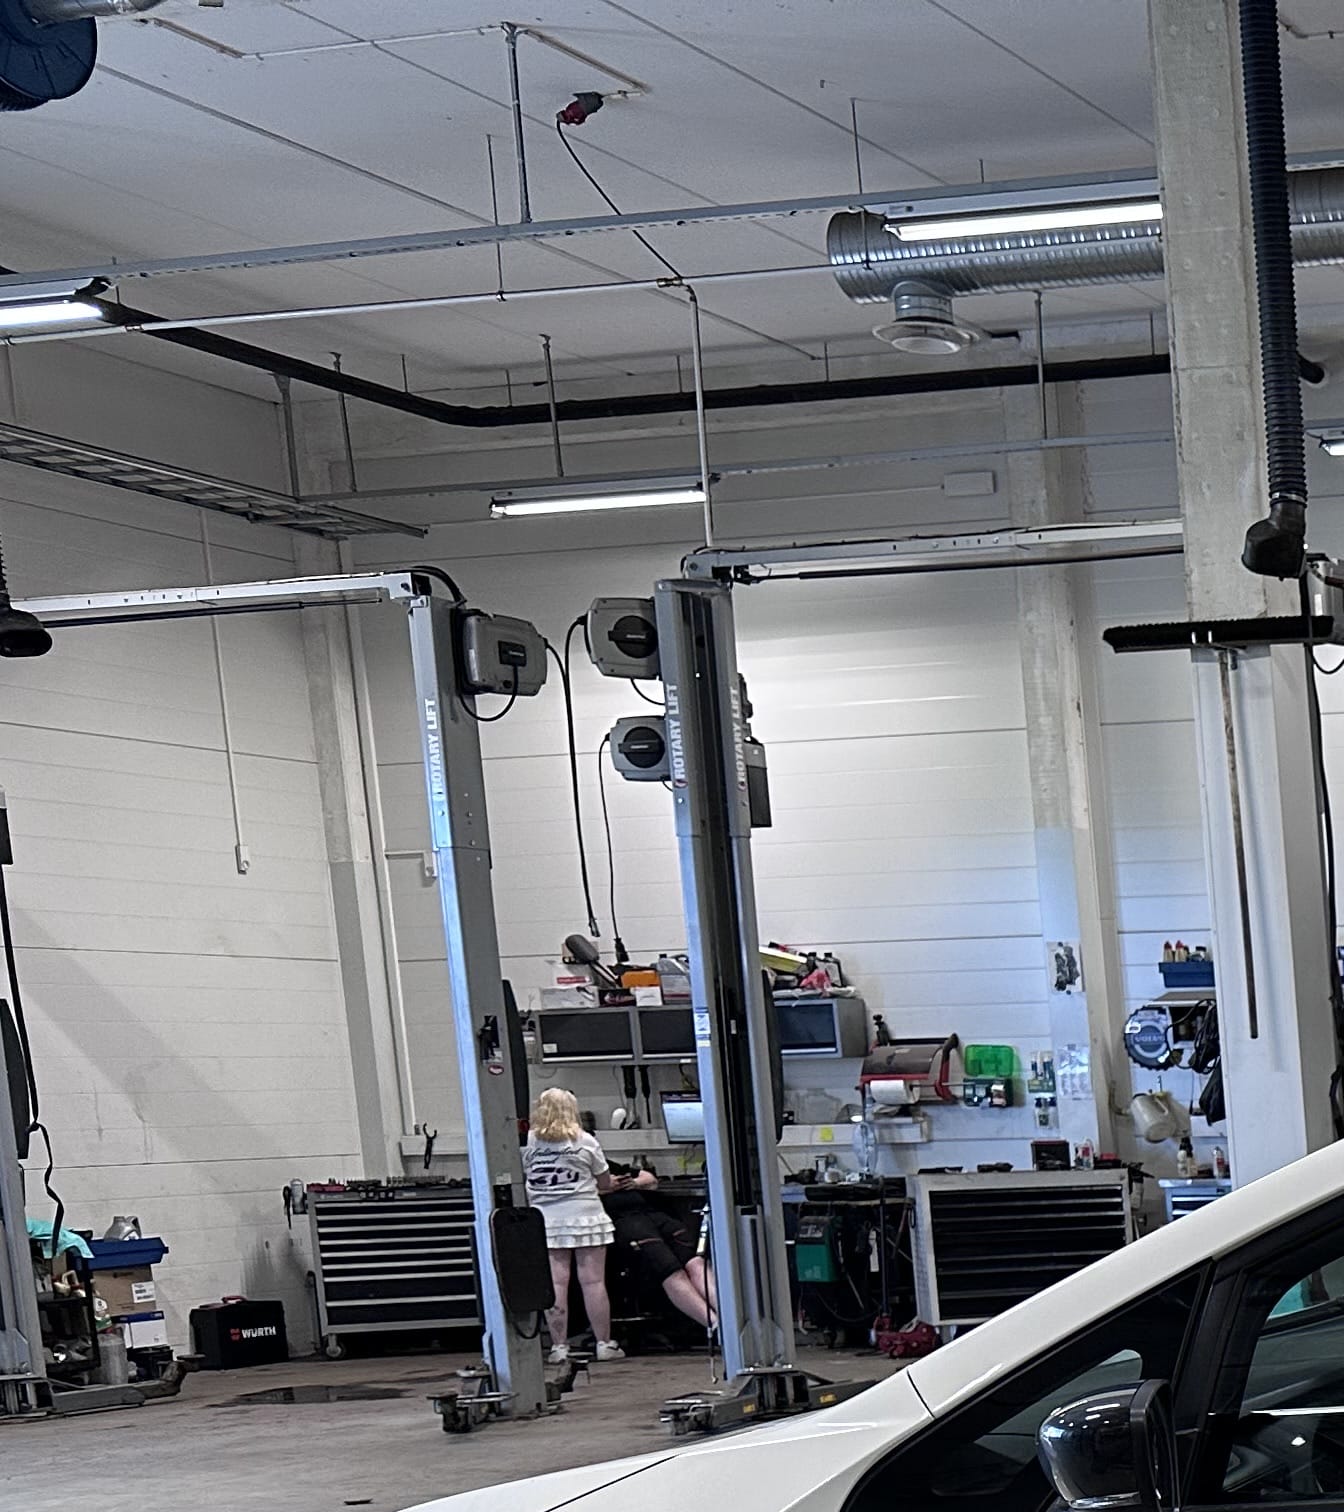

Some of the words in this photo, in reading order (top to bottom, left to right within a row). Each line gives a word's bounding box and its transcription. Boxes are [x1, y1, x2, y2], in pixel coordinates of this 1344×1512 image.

[425, 698, 438, 730] LIFT
[666, 684, 679, 715] LIFT
[730, 687, 740, 719] LIFT
[670, 719, 685, 780] ROTARY
[732, 722, 745, 782] ROTARY
